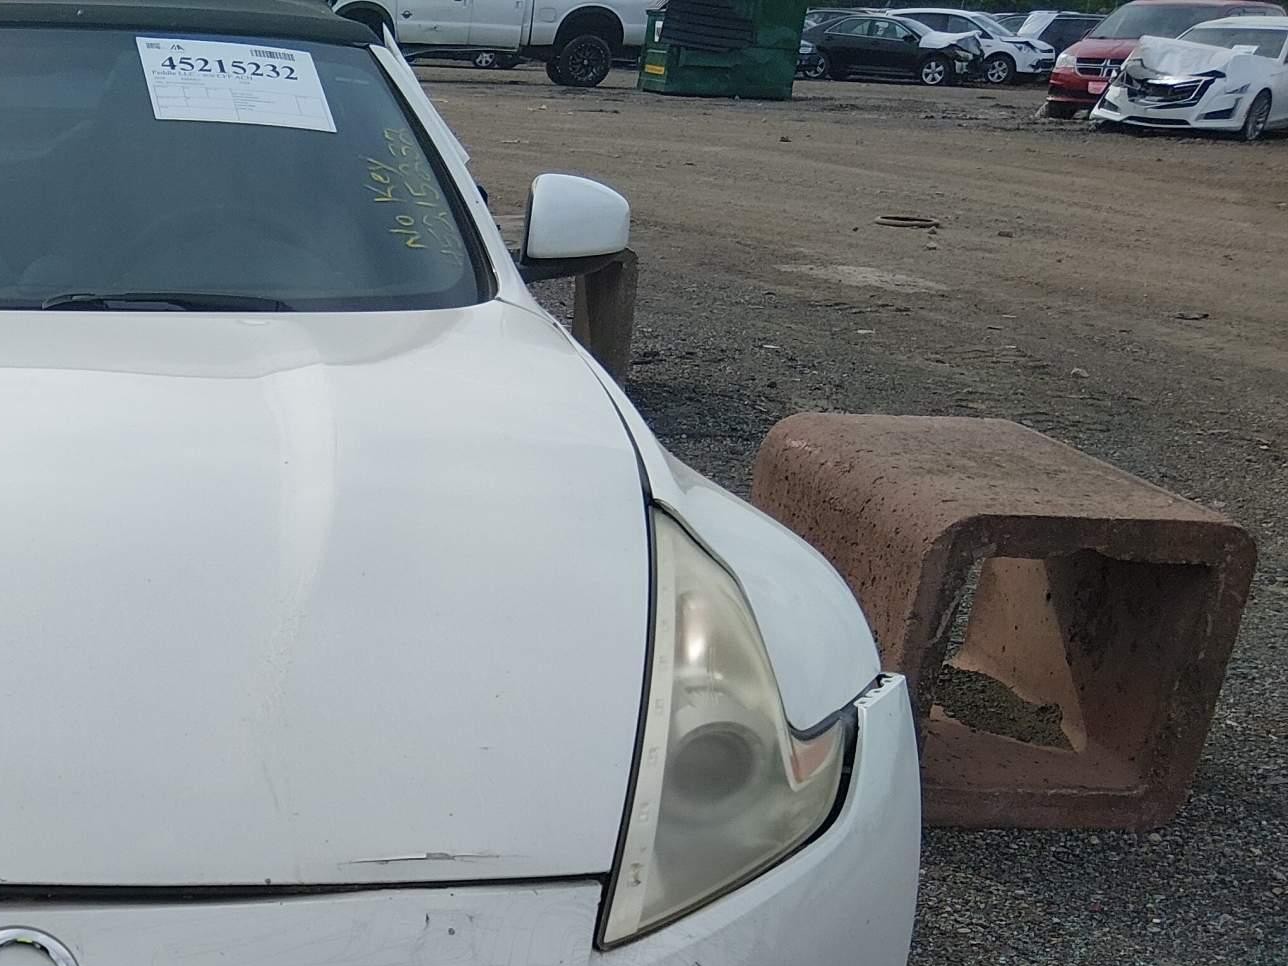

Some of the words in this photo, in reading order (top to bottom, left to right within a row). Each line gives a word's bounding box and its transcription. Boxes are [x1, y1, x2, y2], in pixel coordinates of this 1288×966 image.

[161, 56, 298, 81] 45215232
[359, 154, 407, 202] Key
[389, 215, 426, 248] No
